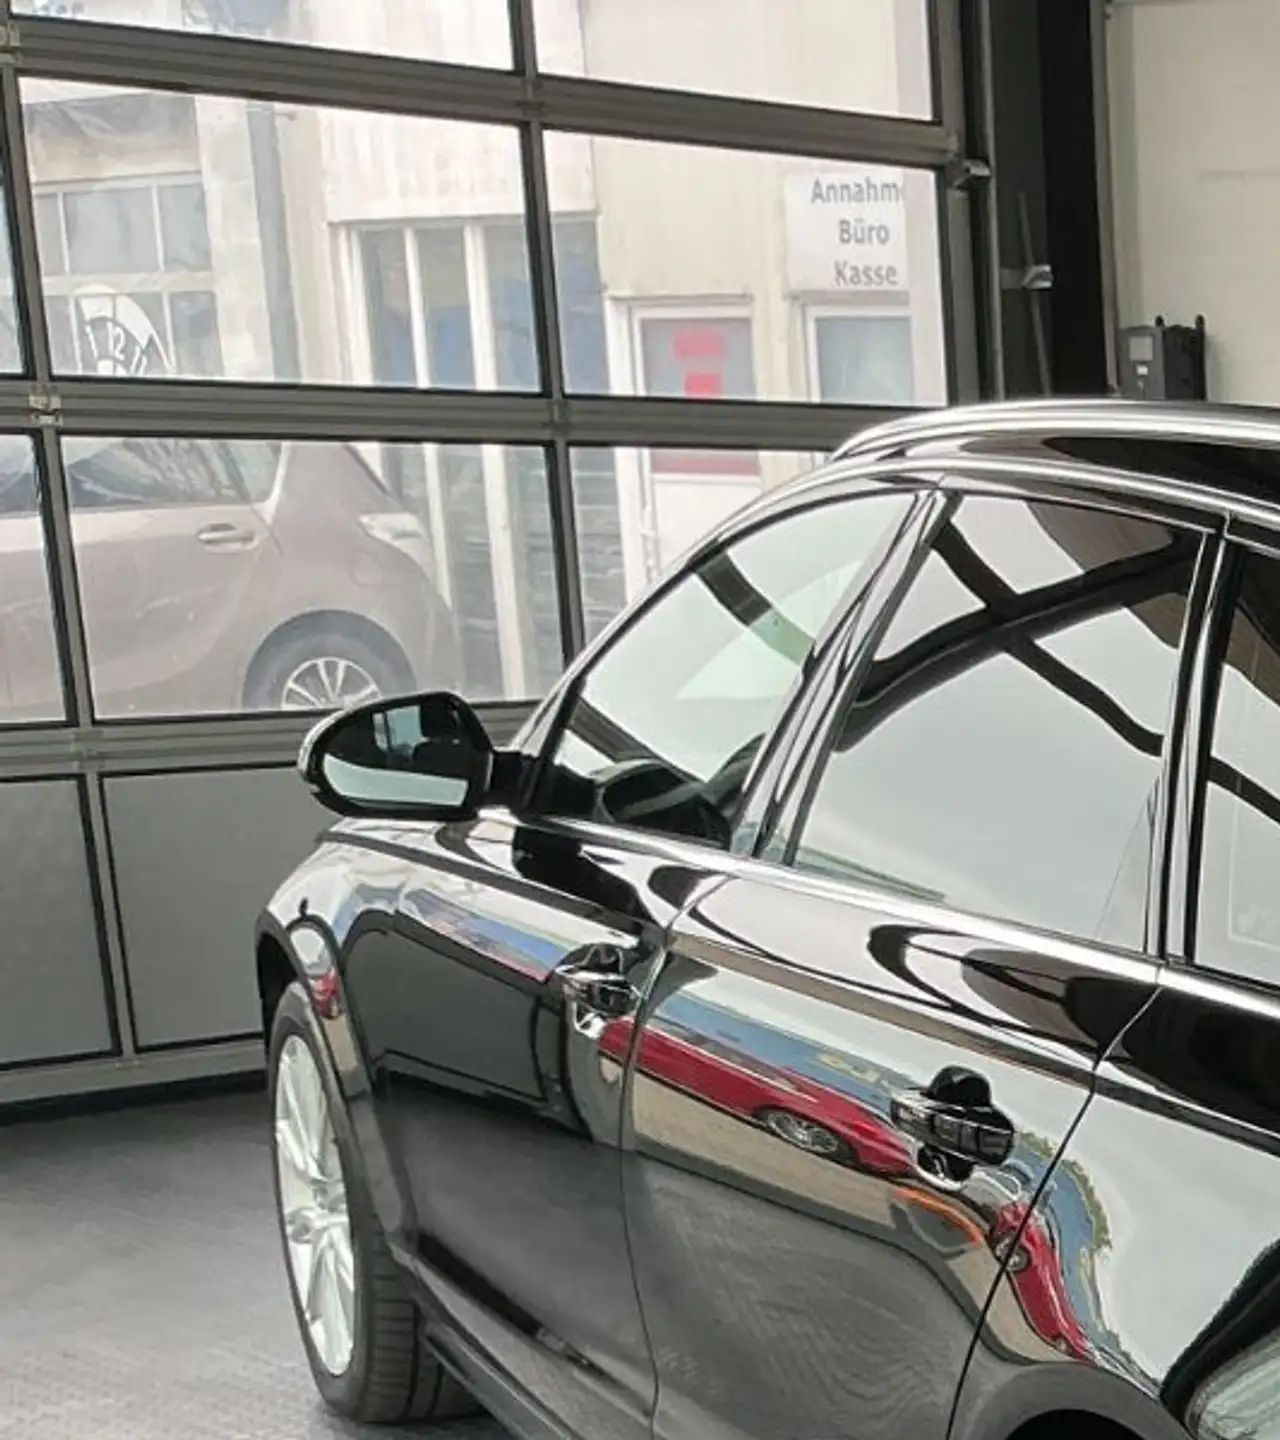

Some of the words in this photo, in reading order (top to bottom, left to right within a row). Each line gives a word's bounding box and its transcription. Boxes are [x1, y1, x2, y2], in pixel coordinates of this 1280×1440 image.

[810, 176, 904, 204] Annahm
[838, 217, 890, 246] Büro
[833, 259, 899, 287] Kasse
